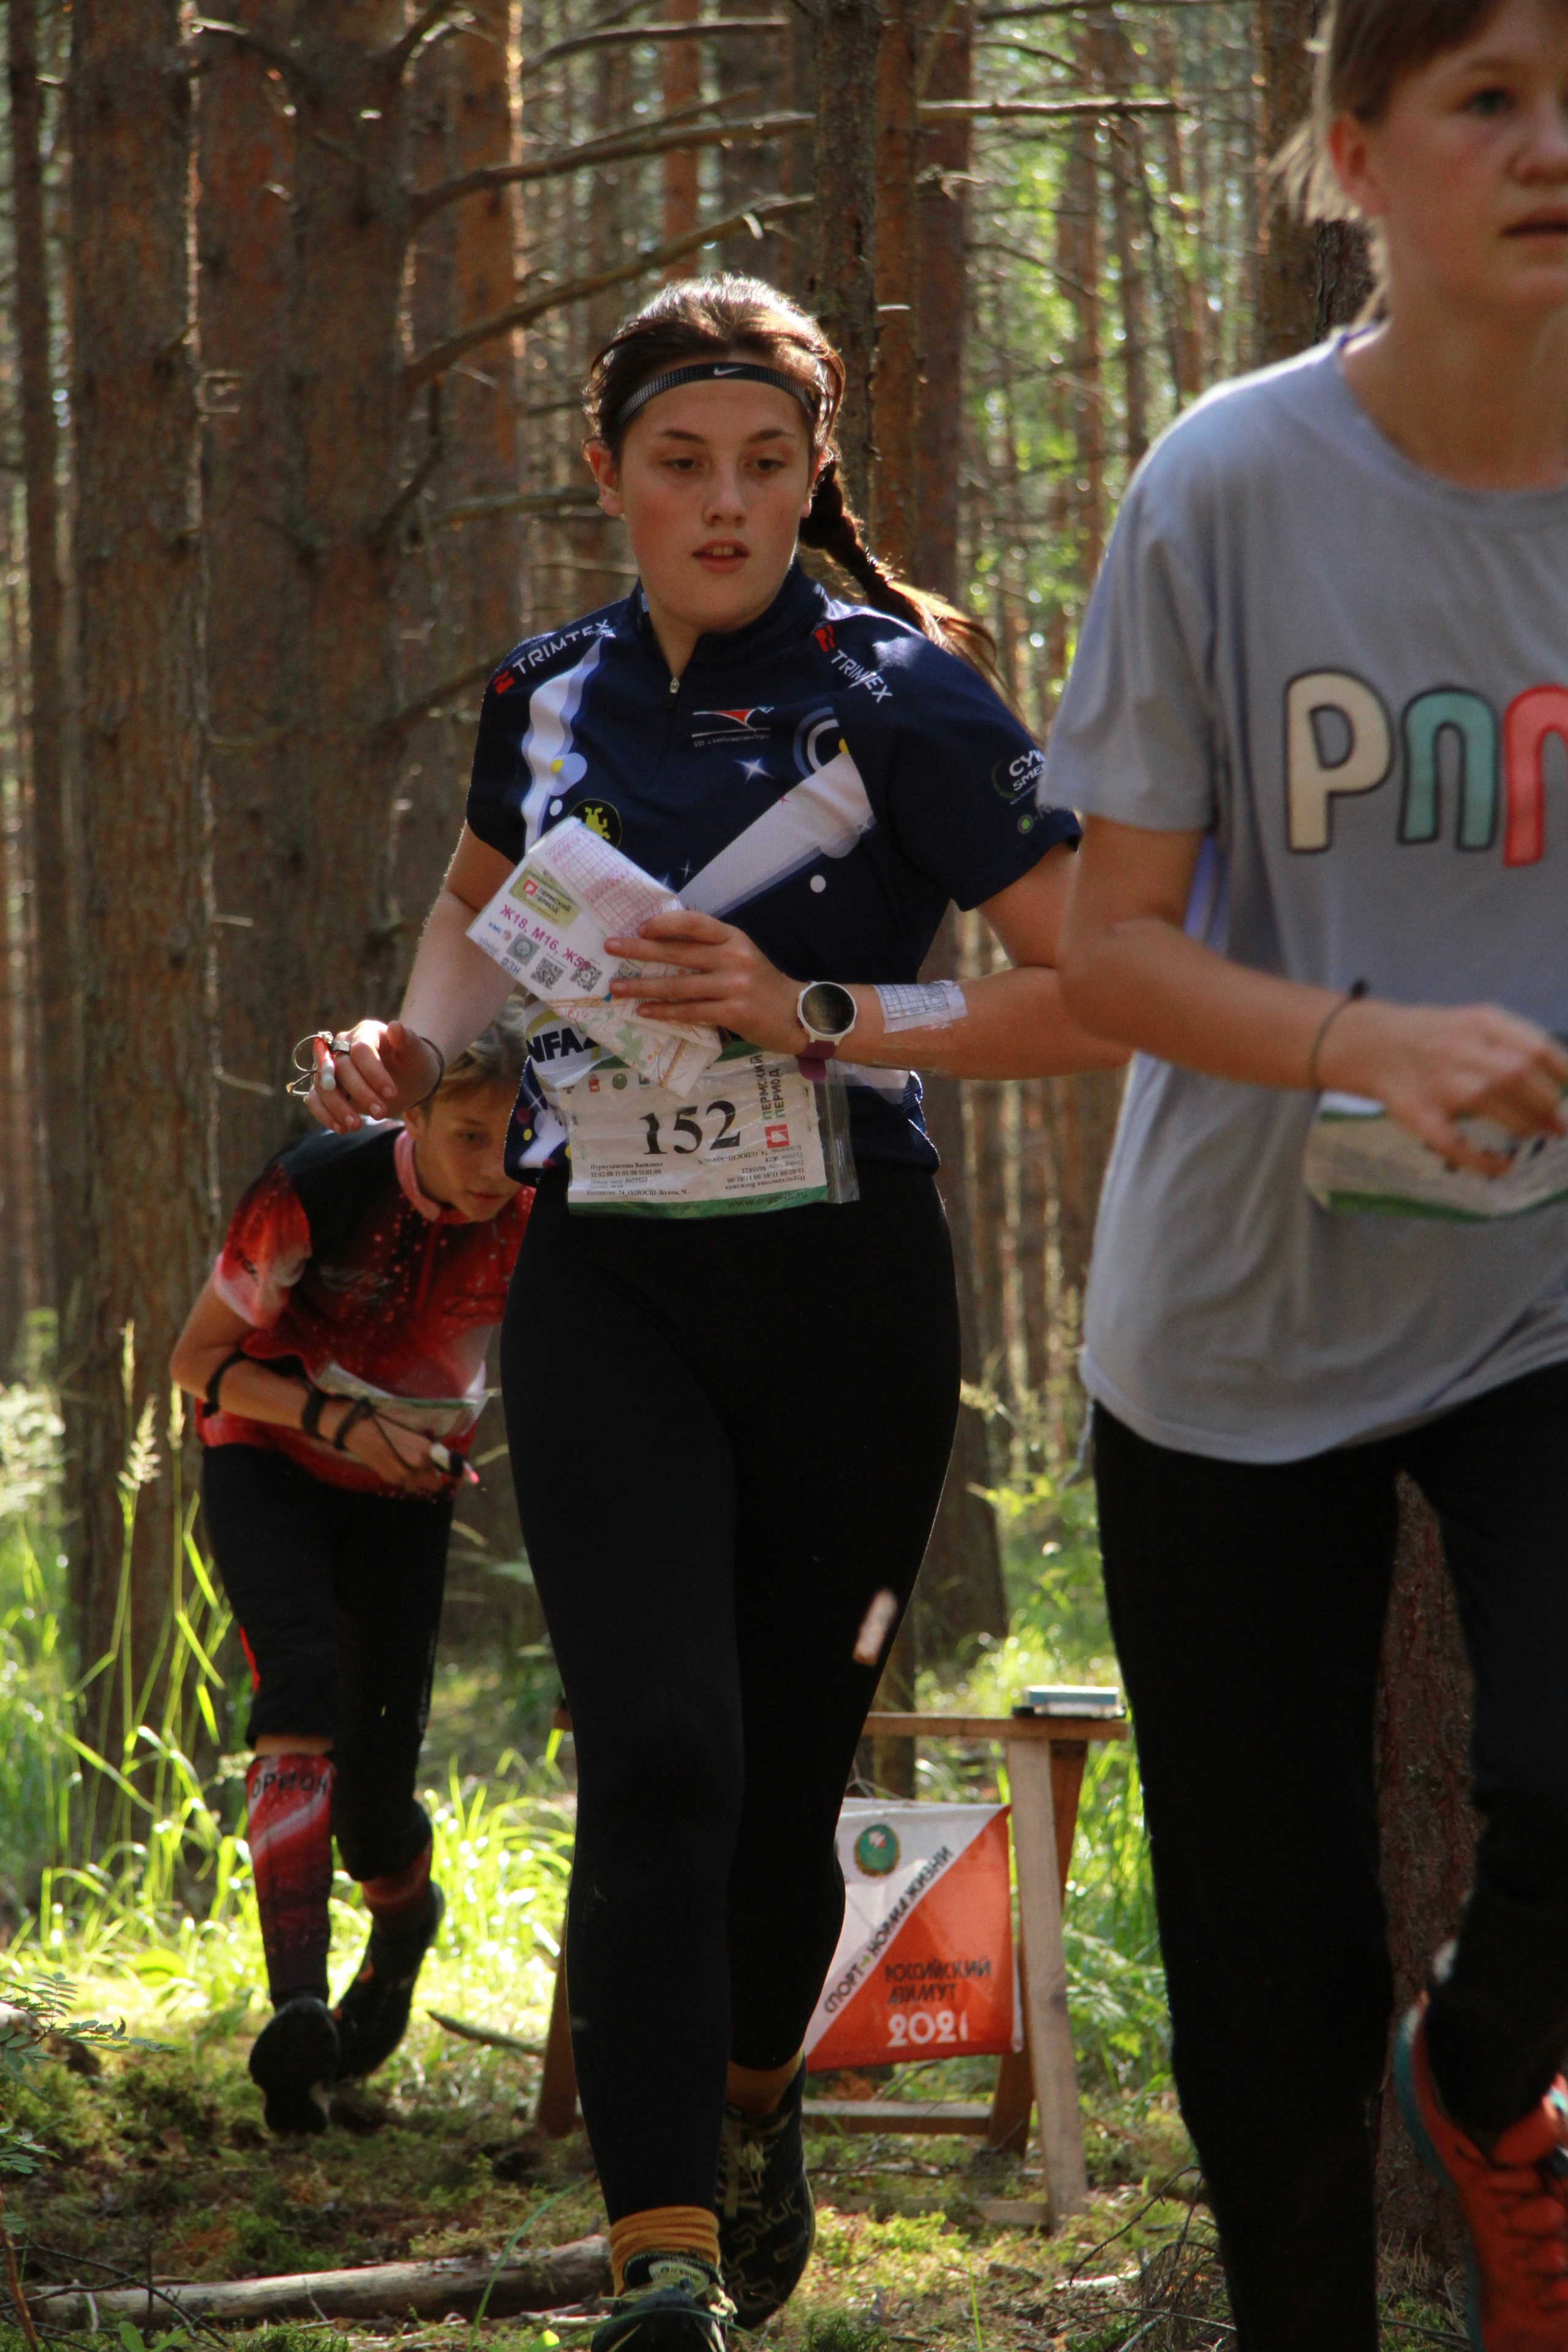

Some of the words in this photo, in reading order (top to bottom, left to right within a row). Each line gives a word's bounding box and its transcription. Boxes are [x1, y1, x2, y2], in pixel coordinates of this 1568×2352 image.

[511, 619, 610, 674] TRIMTEX
[750, 1052, 773, 1120] ПЕРМСКИЙ
[772, 1067, 787, 1119] ПЕРИОД
[639, 1100, 741, 1155] 152
[824, 1962, 864, 2014] СПОРТ
[866, 1894, 911, 1958] НОРМА
[887, 2010, 969, 2048] 2021
